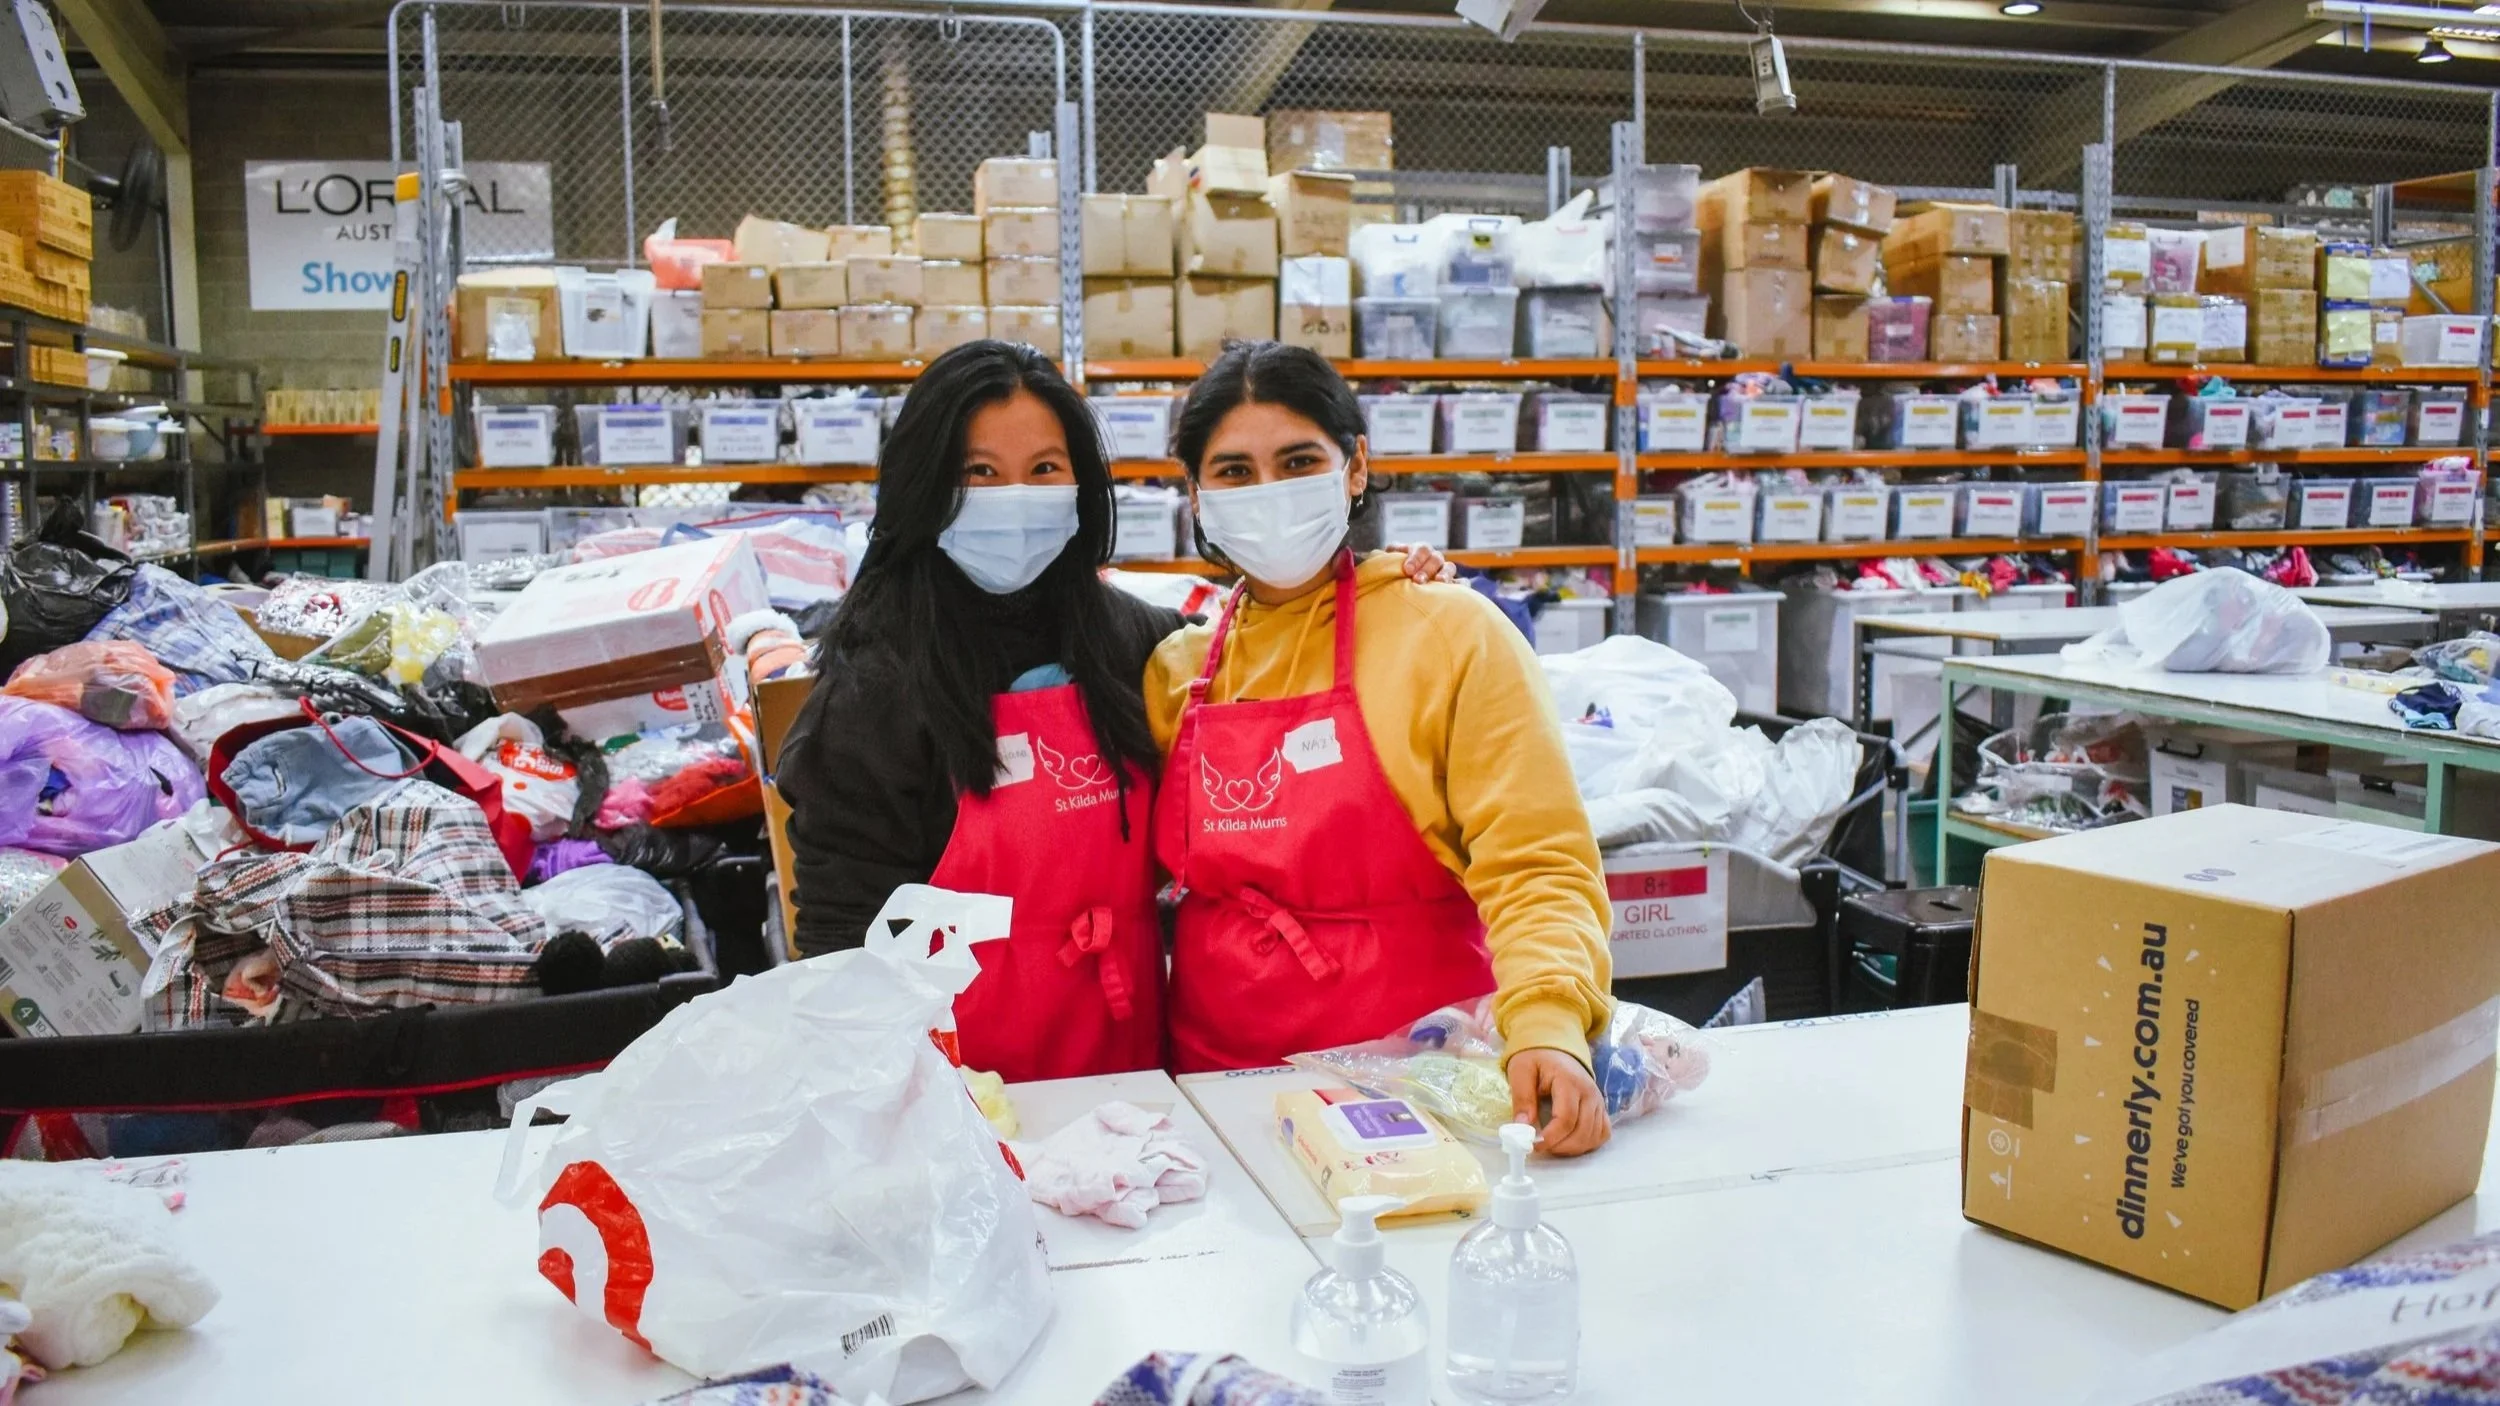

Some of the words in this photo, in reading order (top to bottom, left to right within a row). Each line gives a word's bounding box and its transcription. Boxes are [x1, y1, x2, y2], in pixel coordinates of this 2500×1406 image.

[276, 173, 525, 216] L'ORAL
[336, 224, 393, 241] AUST
[1055, 798, 1067, 813] St
[1069, 792, 1098, 810] Kilda
[1203, 819, 1215, 832] St
[1218, 818, 1247, 832] Kilda
[1249, 816, 1287, 831] Mums
[1644, 876, 1669, 895] 8+
[1624, 903, 1675, 925] GIRL
[1612, 930, 1649, 942] ORTED
[1653, 924, 1709, 939] CLOTHING
[21, 1006, 33, 1018] 4
[2183, 998, 2200, 1071] covered
[2116, 922, 2167, 1240] dinnerly.com.au
[2179, 1072, 2196, 1105] you
[2178, 1104, 2194, 1137] got
[2171, 1135, 2189, 1189] We've
